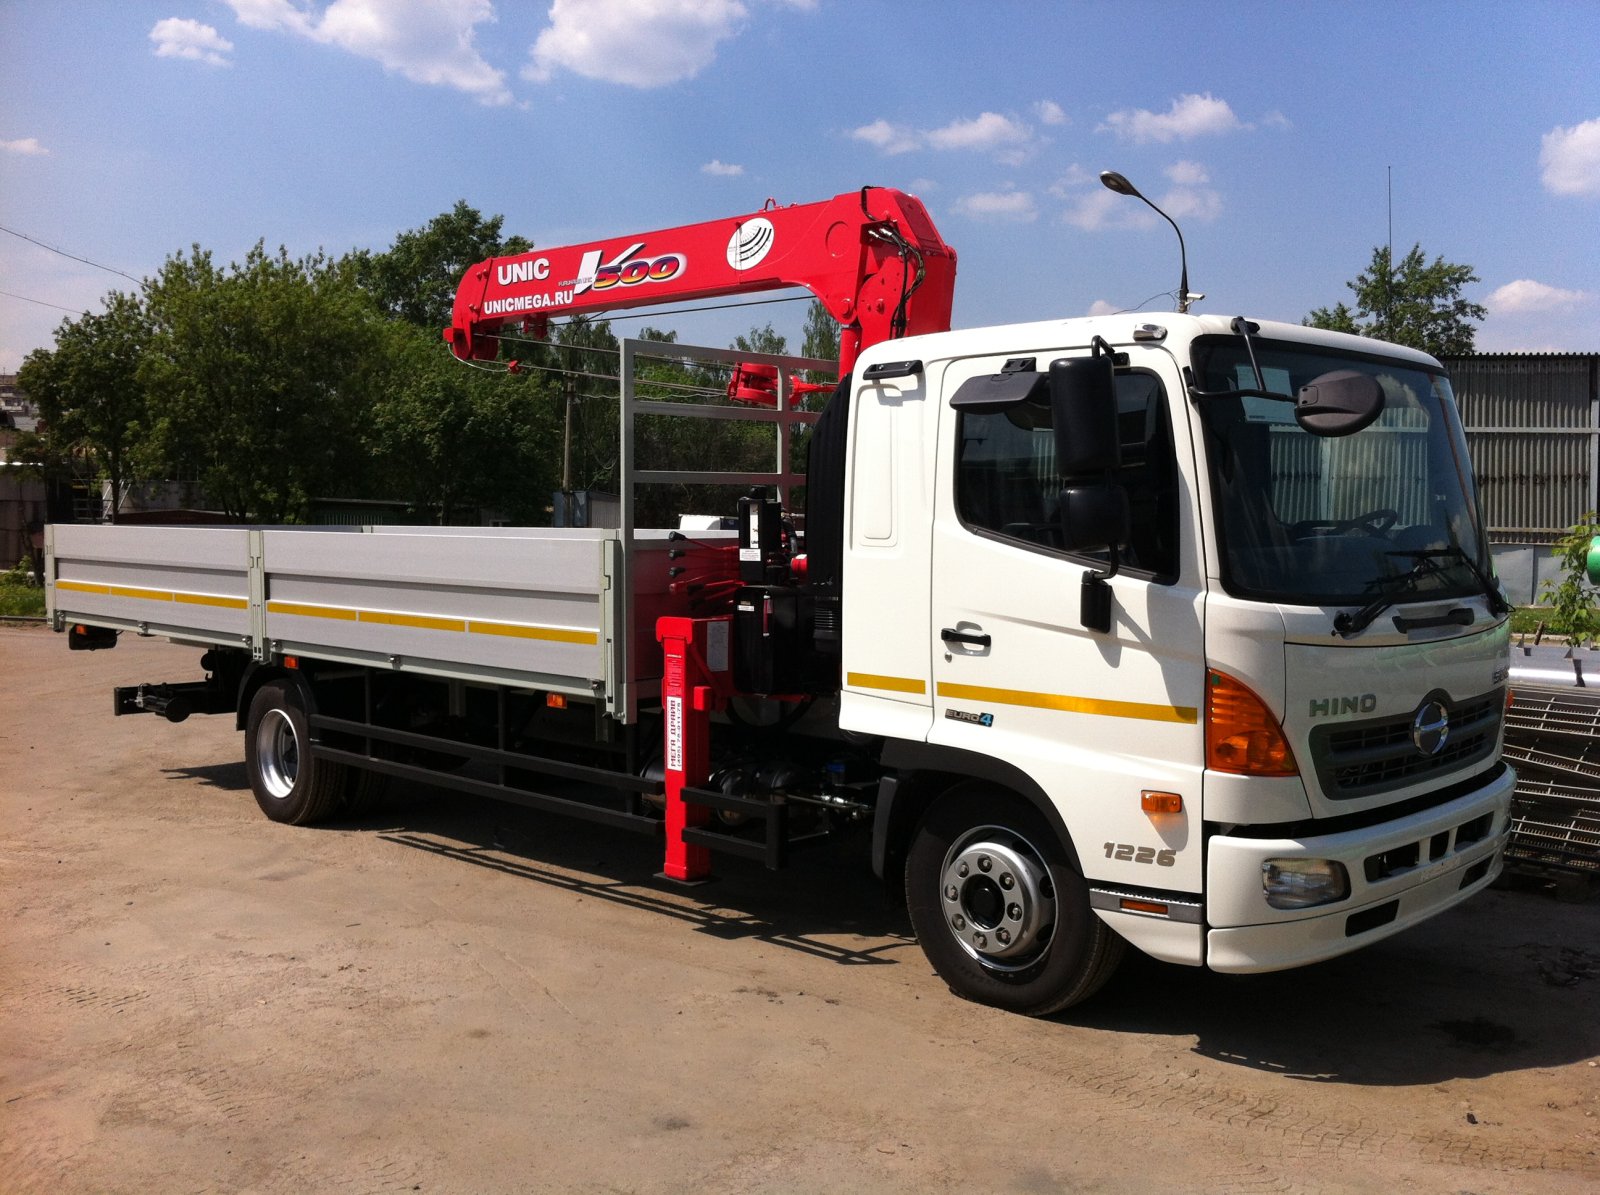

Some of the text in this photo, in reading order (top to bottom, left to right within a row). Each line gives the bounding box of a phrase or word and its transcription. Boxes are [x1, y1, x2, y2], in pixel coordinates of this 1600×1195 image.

[498, 258, 550, 286] UNIC
[484, 290, 574, 315] UNICMEGA.RU
[1309, 693, 1377, 717] HINO
[1103, 842, 1177, 867] 1226
